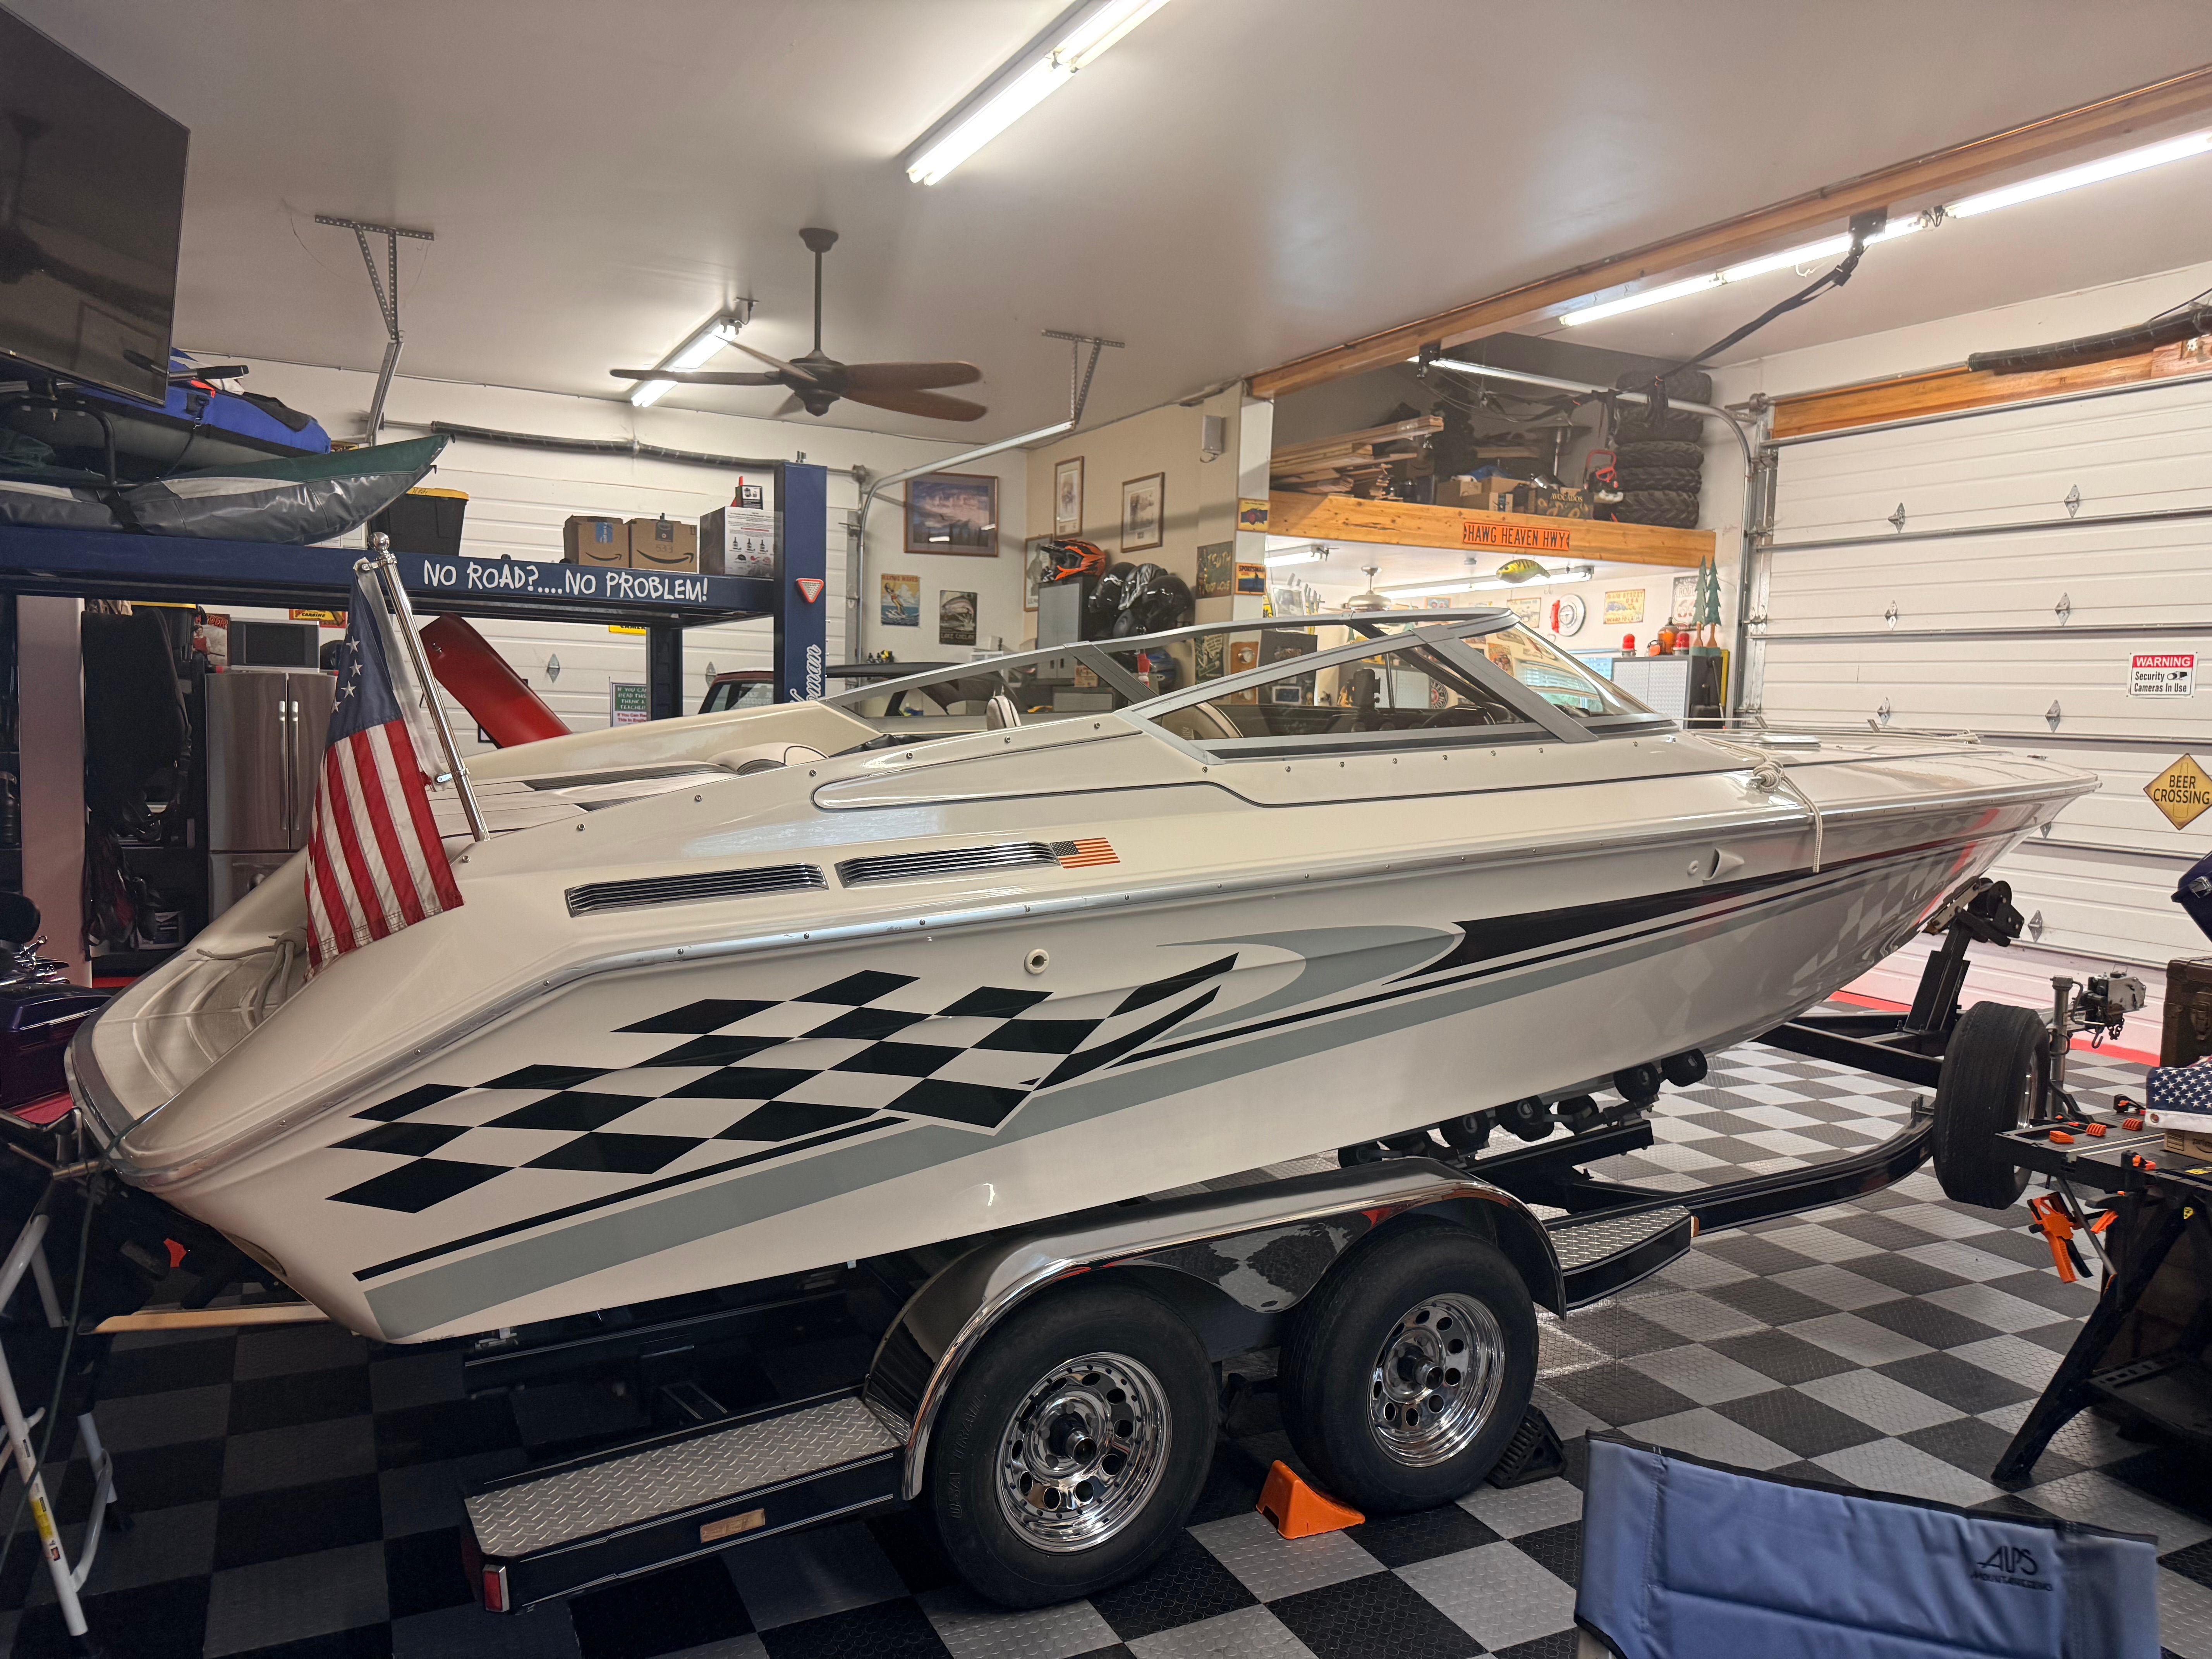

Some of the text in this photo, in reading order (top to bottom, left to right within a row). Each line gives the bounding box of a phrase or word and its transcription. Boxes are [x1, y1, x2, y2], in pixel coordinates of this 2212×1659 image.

[1551, 493, 1583, 503] AVOCADOS
[1467, 524, 1565, 548] HAWG HEAVEN HWY
[424, 560, 457, 587] NO
[606, 572, 708, 603] PROBLEM!
[2136, 656, 2191, 667] WARNING
[2135, 671, 2165, 682] Security
[2134, 683, 2187, 692] Cameras In Use
[2169, 775, 2196, 789] BEER
[2154, 788, 2210, 805] CROSSING
